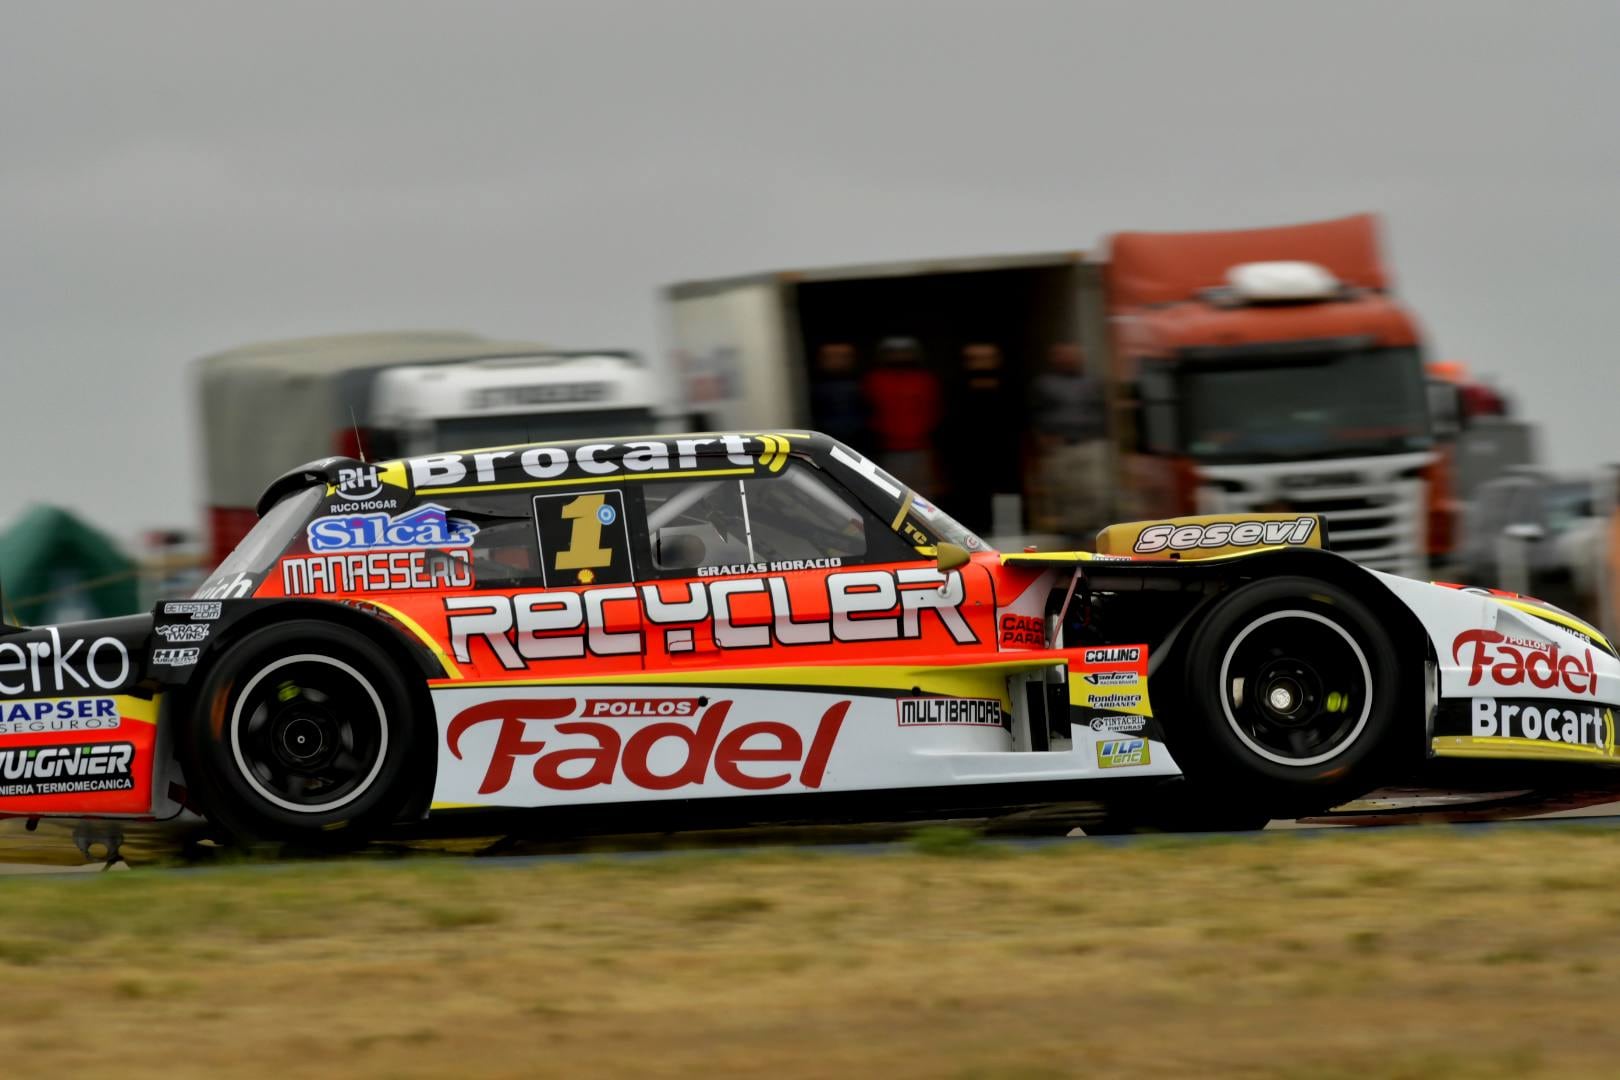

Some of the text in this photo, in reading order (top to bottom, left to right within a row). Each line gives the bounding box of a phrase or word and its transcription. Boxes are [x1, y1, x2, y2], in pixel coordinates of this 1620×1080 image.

[410, 435, 755, 487] Brocart
[338, 466, 378, 492] RH
[330, 500, 397, 513] RUCO HOGAR
[555, 494, 613, 570] 1
[1134, 518, 1316, 552] sesevi
[282, 550, 471, 596] MANASSERO
[697, 557, 841, 577] GRACIAS HORACIO
[167, 632, 204, 641] TWINS
[170, 625, 207, 634] CRAZY
[1511, 637, 1547, 650] POLLOS
[1086, 649, 1139, 662] COLLINO
[1452, 628, 1598, 696] Fadel
[1088, 694, 1141, 703] Rondinara
[594, 701, 690, 717] POLLOS
[902, 700, 1000, 723] MULTIBANDAS
[1103, 716, 1144, 726] TINTACRIL
[1472, 697, 1603, 748] Brocart
[446, 697, 852, 795] Fadel
[37, 778, 132, 793] TERMOMECANICA
